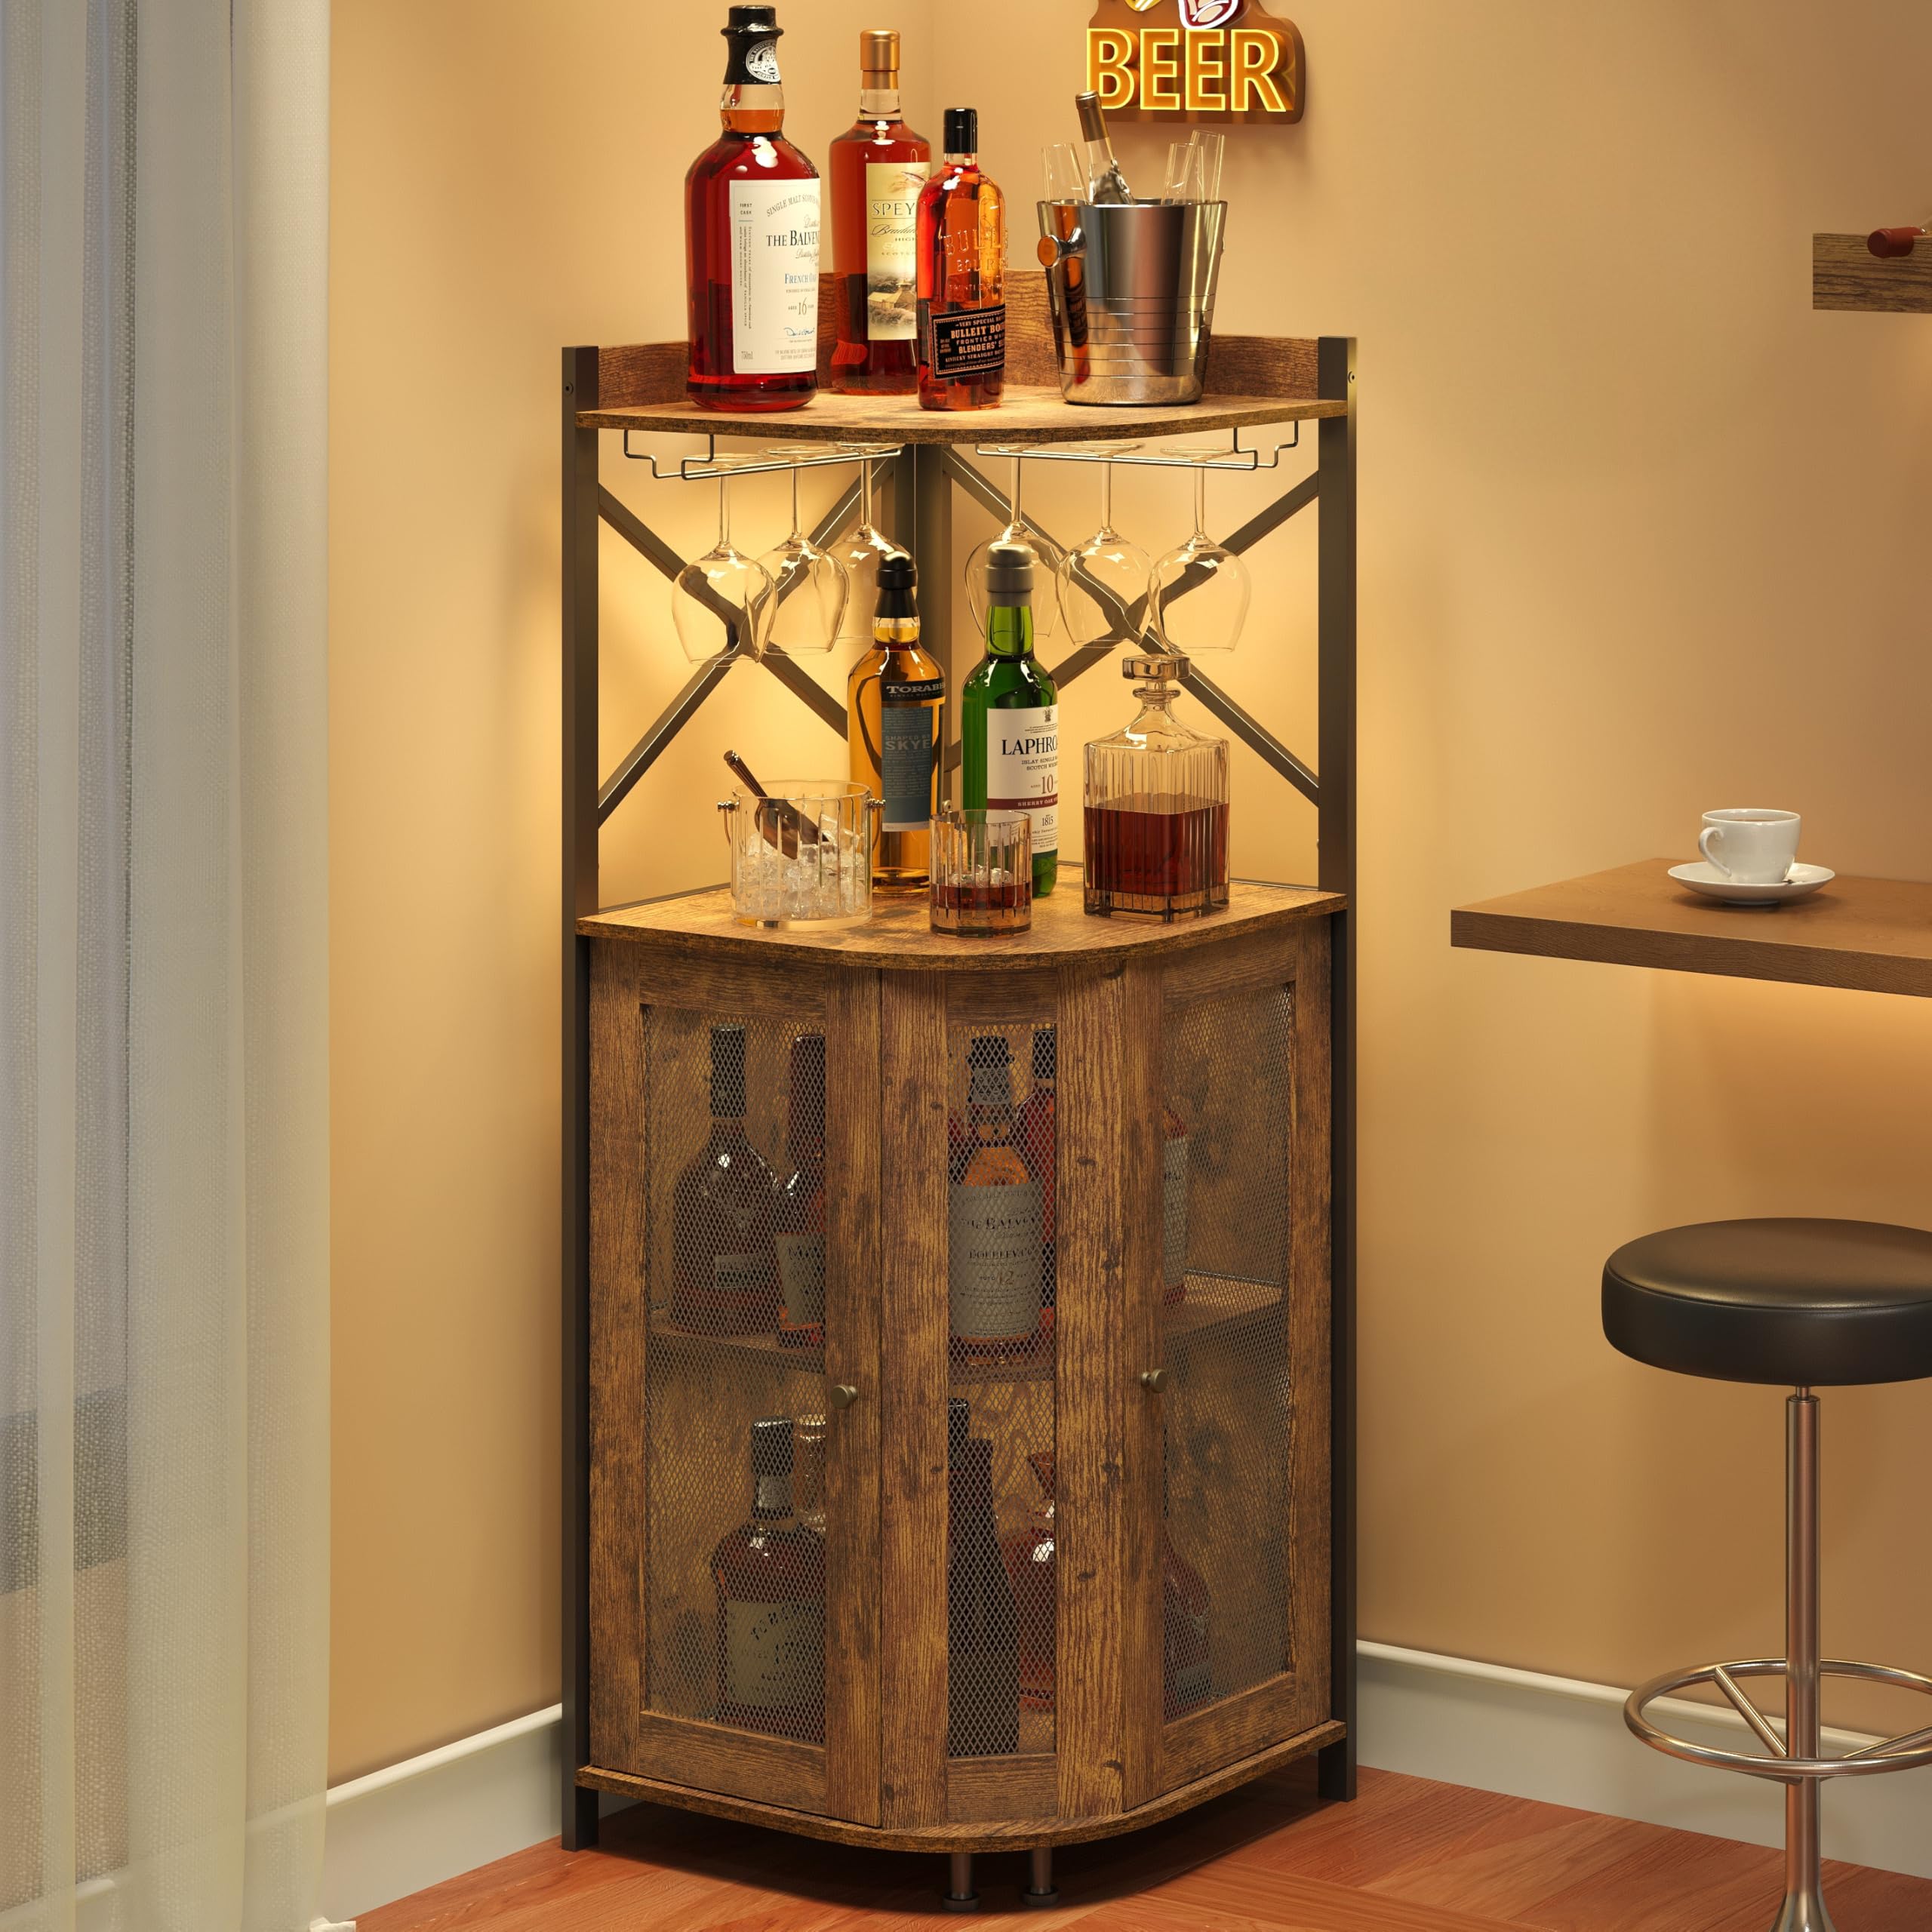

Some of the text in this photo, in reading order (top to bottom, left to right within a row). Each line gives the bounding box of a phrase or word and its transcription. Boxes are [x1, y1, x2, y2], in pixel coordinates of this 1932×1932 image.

[1086, 28, 1287, 112] BEER
[766, 198, 787, 217] SINGLE
[872, 202, 915, 216] SPEY
[766, 235, 788, 247] THE
[785, 273, 808, 285] FRENCH
[798, 297, 808, 315] 16
[973, 317, 995, 326] SPECIAL
[951, 325, 986, 339] BULLEIT
[956, 335, 992, 346] FRONTIER
[967, 351, 994, 360] STRAIGHT
[885, 739, 931, 751] SKYE
[1041, 774, 1054, 795] 10
[1041, 816, 1054, 826] 1815
